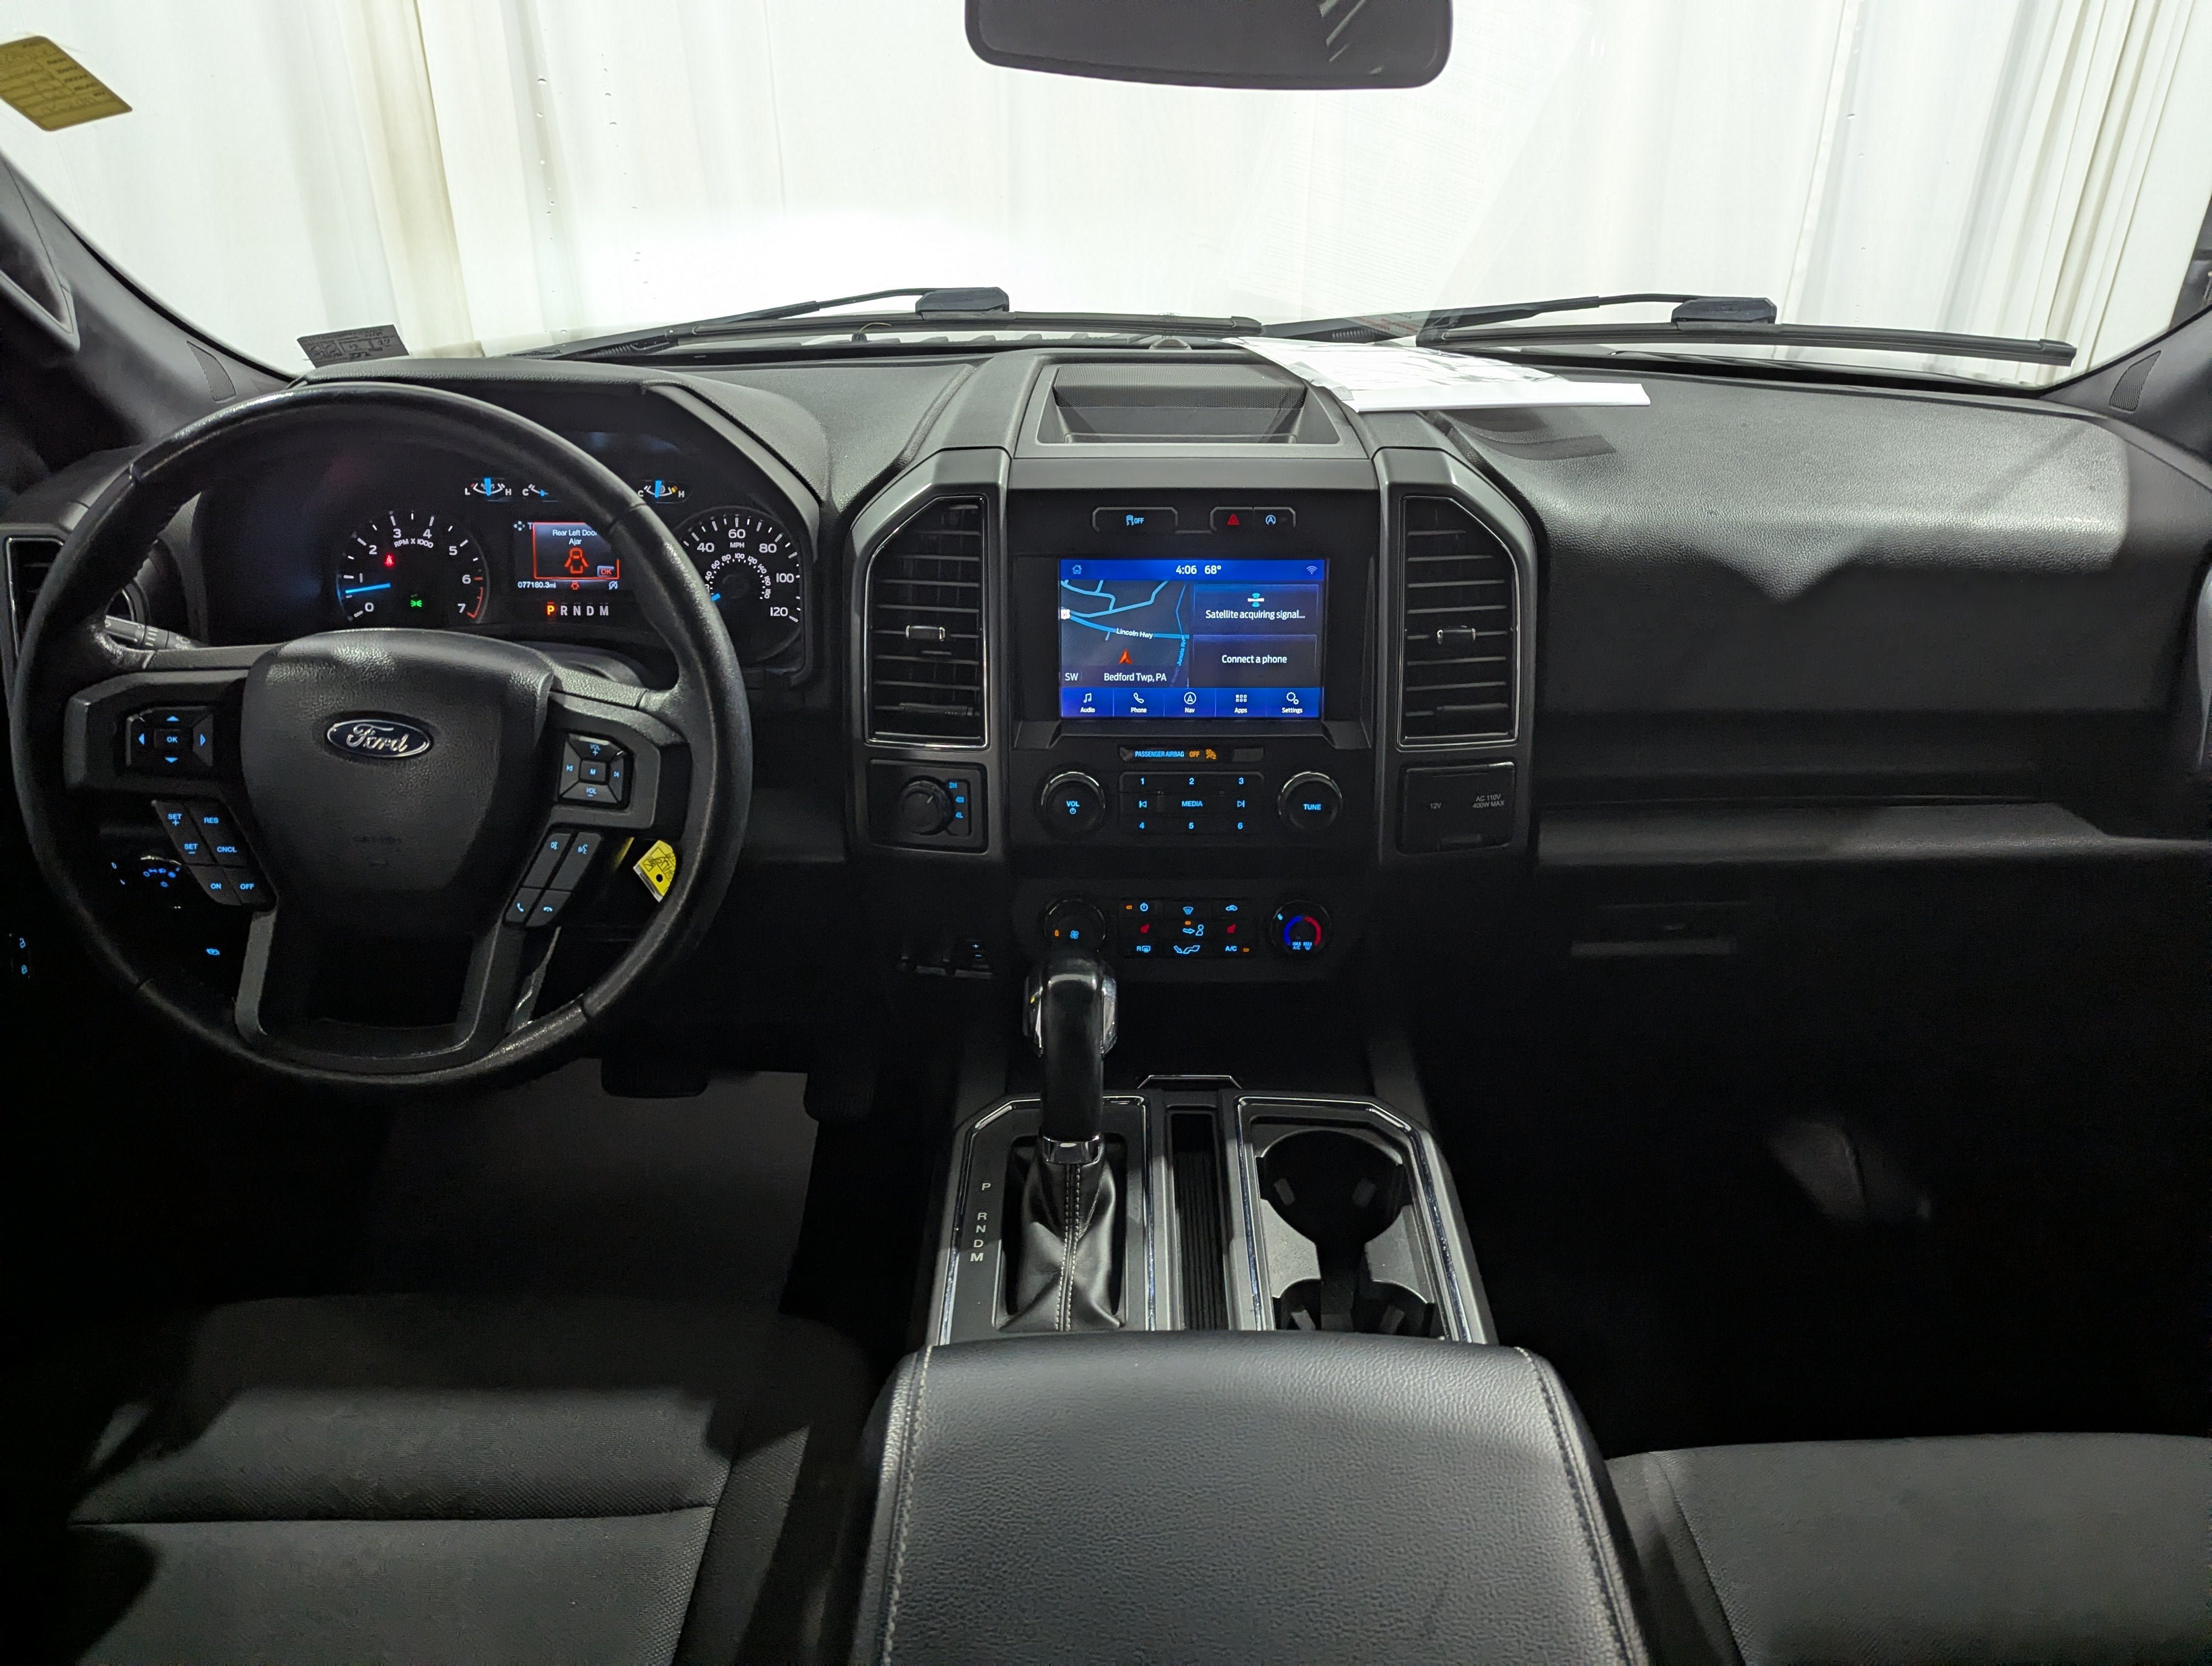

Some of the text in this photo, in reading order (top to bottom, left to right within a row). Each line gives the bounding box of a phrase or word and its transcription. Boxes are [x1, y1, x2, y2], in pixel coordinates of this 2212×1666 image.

[393, 529, 401, 538] 3
[423, 529, 432, 539] 4
[728, 529, 746, 539] 60
[394, 539, 409, 548] RPM
[417, 539, 434, 548] 1000
[697, 542, 715, 553] 40
[759, 543, 777, 553] 80
[369, 545, 377, 554] 2
[449, 546, 458, 555] 5
[721, 554, 731, 562] 80
[748, 555, 758, 565] 120
[711, 560, 720, 569] 60
[1175, 565, 1221, 575] 4:06 68°
[359, 573, 363, 582] 1
[462, 574, 471, 584] 6
[776, 573, 794, 583] 100
[365, 603, 374, 612] 0
[458, 604, 466, 613] 7
[547, 605, 608, 616] P R N D M
[770, 607, 788, 617] 120
[1206, 610, 1238, 619] Satellite
[1240, 610, 1275, 621] acquiring
[1116, 628, 1154, 640] Lincoln Hwy
[1221, 655, 1255, 663] Connect
[1262, 655, 1287, 665] phone
[1065, 673, 1078, 681] SW
[1104, 673, 1167, 683] Bedford Twp, PA
[346, 723, 409, 752] Ford
[977, 1212, 987, 1220] R
[976, 1225, 986, 1233] N
[973, 1239, 983, 1248] D
[970, 1253, 983, 1261] M
